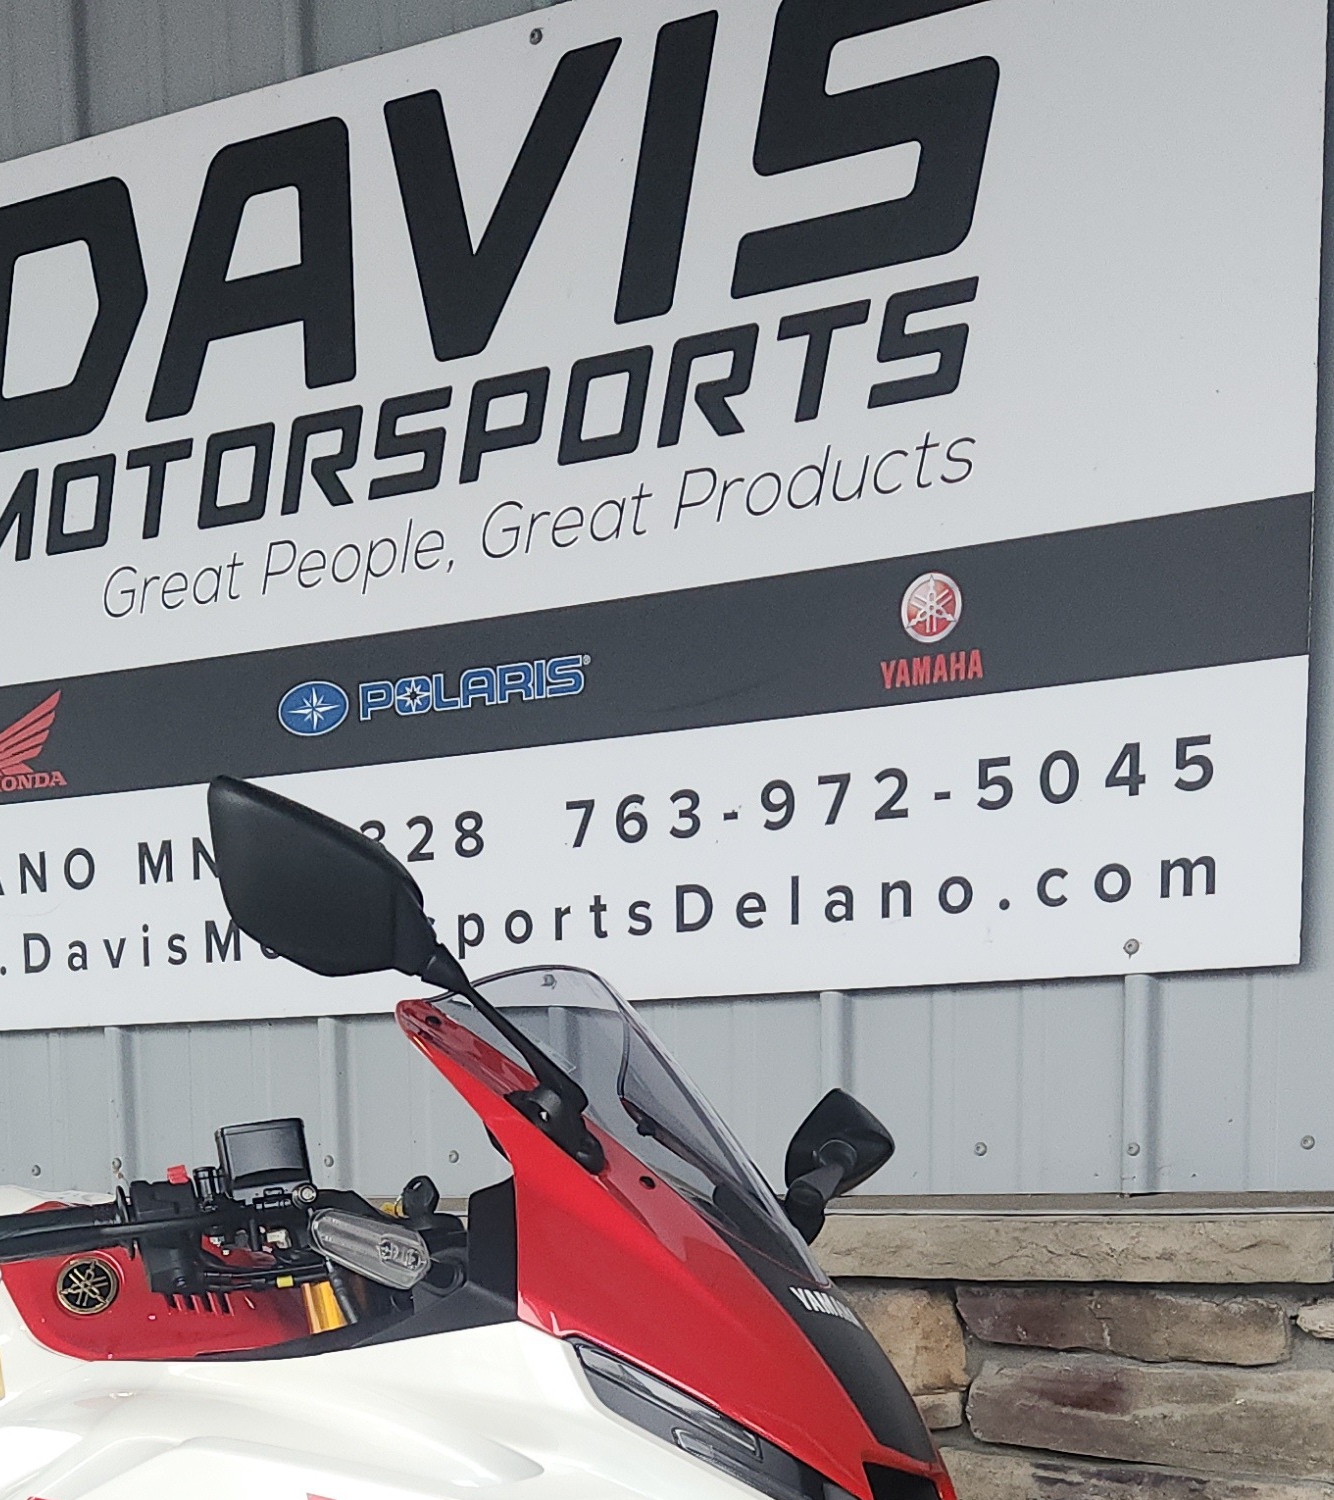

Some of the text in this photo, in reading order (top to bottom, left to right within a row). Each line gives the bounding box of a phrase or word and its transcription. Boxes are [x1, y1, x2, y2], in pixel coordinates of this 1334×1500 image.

[102, 430, 977, 618] Great People, Great Products
[880, 648, 984, 690] YAMAHA
[565, 734, 1215, 848] 763-972-5045
